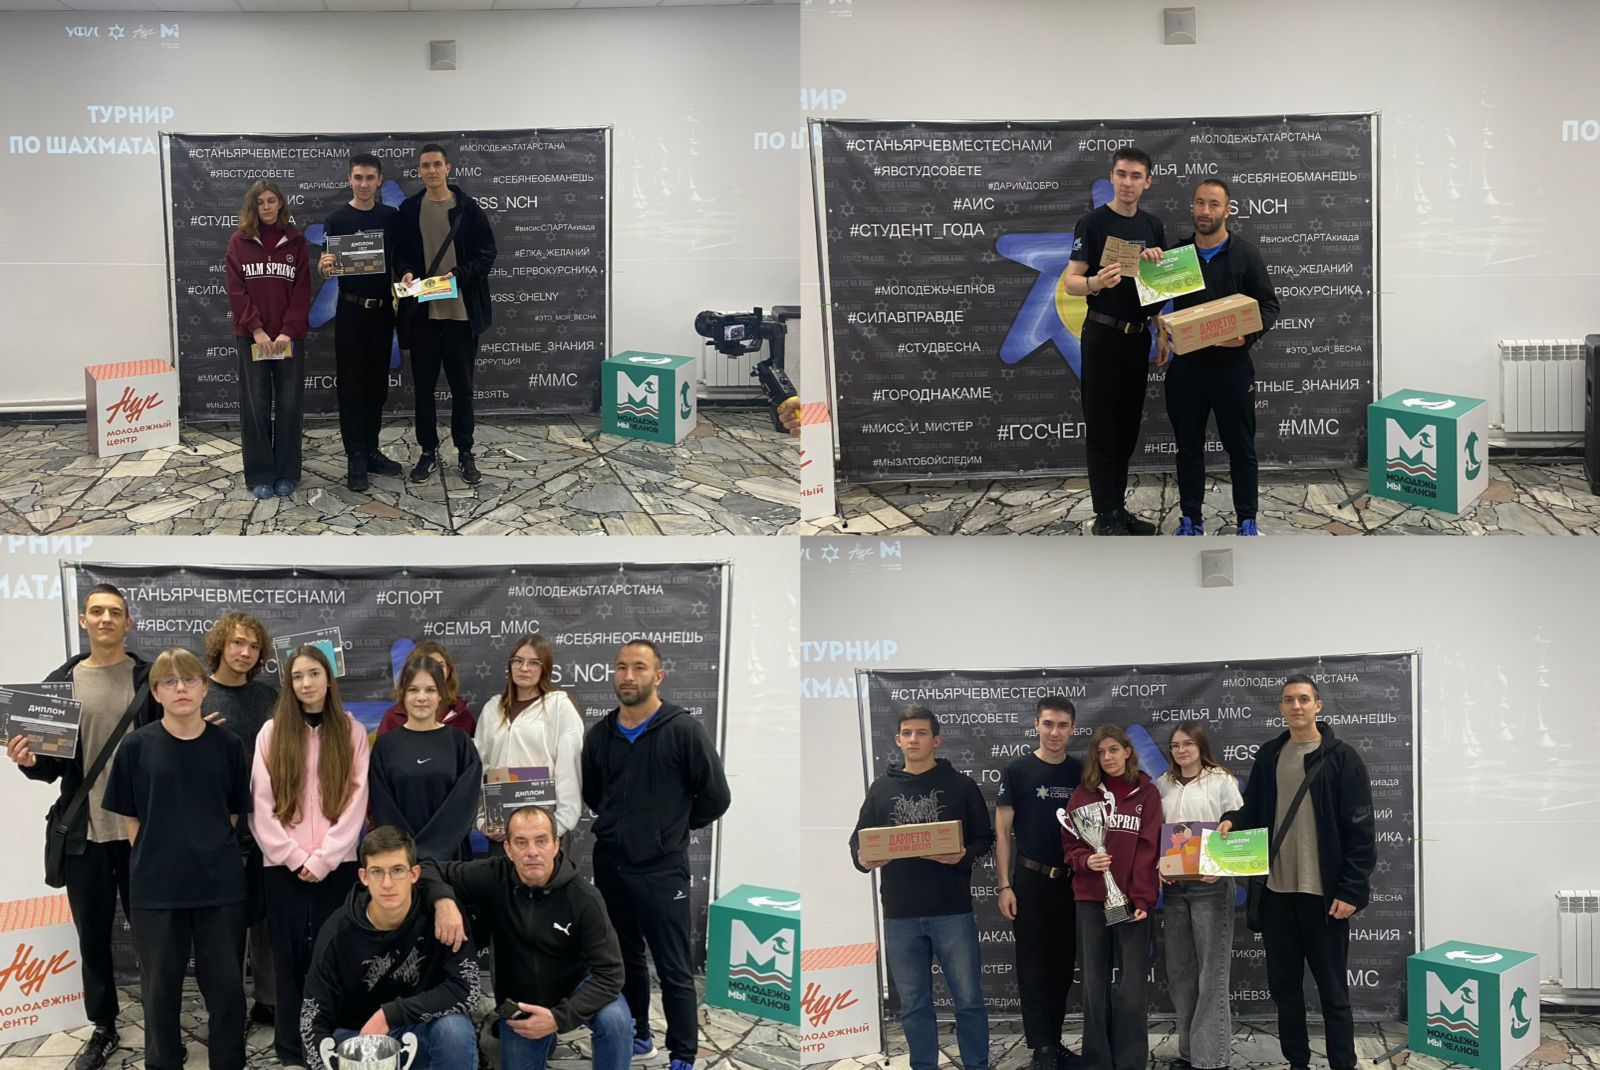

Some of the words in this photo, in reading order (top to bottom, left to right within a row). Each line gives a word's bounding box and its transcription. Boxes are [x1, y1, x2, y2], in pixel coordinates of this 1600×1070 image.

[87, 105, 175, 124] ТУРНИР
[1562, 119, 1600, 142] ПО
[9, 136, 41, 153] ПО
[846, 139, 1053, 152] #СТАНЬЯРЧЕВМЕСТЕСНАМИ
[1078, 139, 1135, 151] #СПОРТ
[1190, 132, 1322, 145] #МОЛОДЕЖЬТАТАРСТАНА
[188, 148, 350, 159] #СТАНЬЯРЧЕВМЕСТЕСНАМИ
[371, 148, 416, 158] #СПОРТ
[459, 142, 566, 152] #МОЛОДЕЖЬТАТАРСТАНА
[210, 169, 295, 179] #ЯВСТУДСОВЕТЕ
[873, 165, 982, 178] #ЯВСТУДСОВЕТЕ
[1150, 163, 1218, 178] МЬЯ_ММС
[1231, 171, 1358, 184] #СЕБЯНЕОБМАНЕШЬ
[493, 173, 594, 184] #СЕБЯНЕОБМАНЕШЬ
[988, 181, 1059, 191] #ДАРИМДОБРО
[287, 195, 305, 205] ИС
[472, 196, 538, 212] SS_NCH
[953, 197, 995, 211] #АИС
[1228, 198, 1288, 219] S_NCH
[849, 223, 985, 240] #СТУДЕНТ_ГОДА
[1260, 233, 1360, 243] #висисСПАРТАкиада
[514, 247, 590, 259] #ЁЛКА_ЖЕЛАНИЙ
[488, 265, 598, 277] ЕНЬ_ПЕРВОКУРСНИКА
[1266, 262, 1353, 277] ЁЛКА_ЖЕЛАНИЙ
[874, 284, 996, 297] #МОЛОДЕЖЬЧЕЛНОВ
[1274, 284, 1363, 297] РВОКУРСНИКА
[847, 310, 964, 323] #СИЛАВПРАВДЕ
[480, 341, 595, 353] #ЧЕСТНЫЕ_ЗНАНИЯ
[897, 341, 981, 354] #СТУДВЕСНА
[1285, 345, 1362, 355] #ЭТО_МОЯ_ВЕСНА
[528, 373, 579, 387] #ММС
[1250, 379, 1360, 394] ТНЫЕ_ЗНАНИЯ
[872, 386, 992, 402] #ГОРОДНАКАМЕ
[106, 420, 172, 437] молодежный
[861, 421, 974, 435] #МИСС_И_МИСТЕР
[997, 421, 1087, 440] #ГССЧЕЛ
[1278, 418, 1340, 436] #ММС
[106, 435, 138, 447] центр
[873, 454, 982, 467] #МЫЗАТОБОЙСЛЕДИМ
[1386, 472, 1437, 490] МОЛОДЕЖЬ
[800, 484, 824, 497] ный
[1386, 481, 1401, 491] МЫ
[1401, 483, 1437, 499] ЧЕЛНОВ
[119, 587, 346, 604] СТАНЬЯРЧЕВМЕСТЕСНАМИ
[376, 590, 443, 605] #СПОРТ
[508, 584, 664, 598] #МОЛОДЕЖЬТАТАРСТАНА
[136, 619, 218, 634] #ЯВСТУДС
[424, 620, 540, 638] #СЕМЬЯ_ММС
[556, 631, 704, 645] #СЕБЯНЕОБМАНЕШЬ
[800, 640, 898, 662] ТУРНИР
[890, 686, 1086, 701] #СТАНЬЯРЧЕВМЕСТЕСНАМИ
[1111, 684, 1168, 698] #СПОРТ
[28, 704, 66, 716] ДИПЛОМ
[1152, 706, 1252, 723] #СЕМЬЯ_ММС
[935, 713, 1019, 725] ВСТУДСОВЕТЕ
[991, 744, 1031, 757] #АИС
[515, 789, 545, 798] ДИПЛОМ
[1110, 814, 1140, 831] SPRIN
[728, 980, 791, 1001] МОЛОДЕЖЬ
[727, 989, 746, 1001] МЫ
[746, 993, 791, 1012] ЧЕЛНОВ
[800, 1022, 870, 1042] олодежный
[1426, 1028, 1479, 1048] МОЛОДЕЖЬ
[1426, 1037, 1442, 1048] МЫ
[1442, 1039, 1479, 1057] ЧЕЛНОВ
